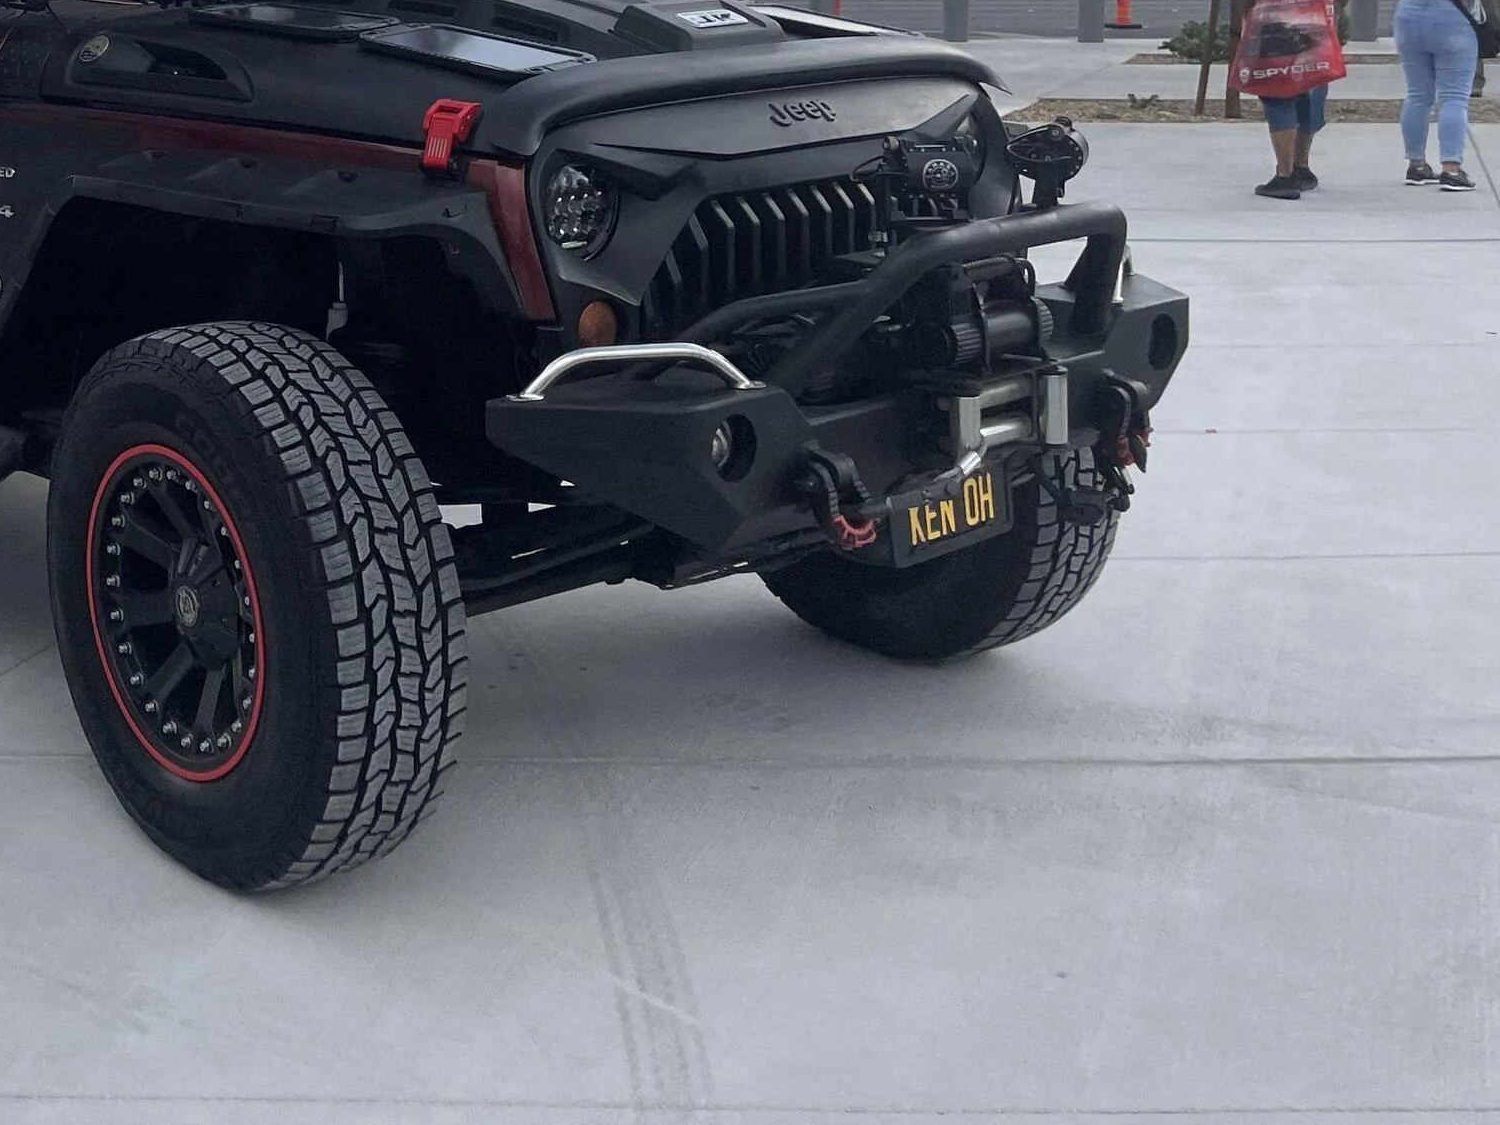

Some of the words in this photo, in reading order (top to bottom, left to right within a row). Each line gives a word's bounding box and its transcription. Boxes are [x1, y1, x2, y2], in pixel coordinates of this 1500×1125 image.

[1253, 61, 1330, 79] SPYDER
[767, 100, 837, 127] Jeep
[907, 500, 956, 546] KEN
[962, 471, 995, 526] OH
